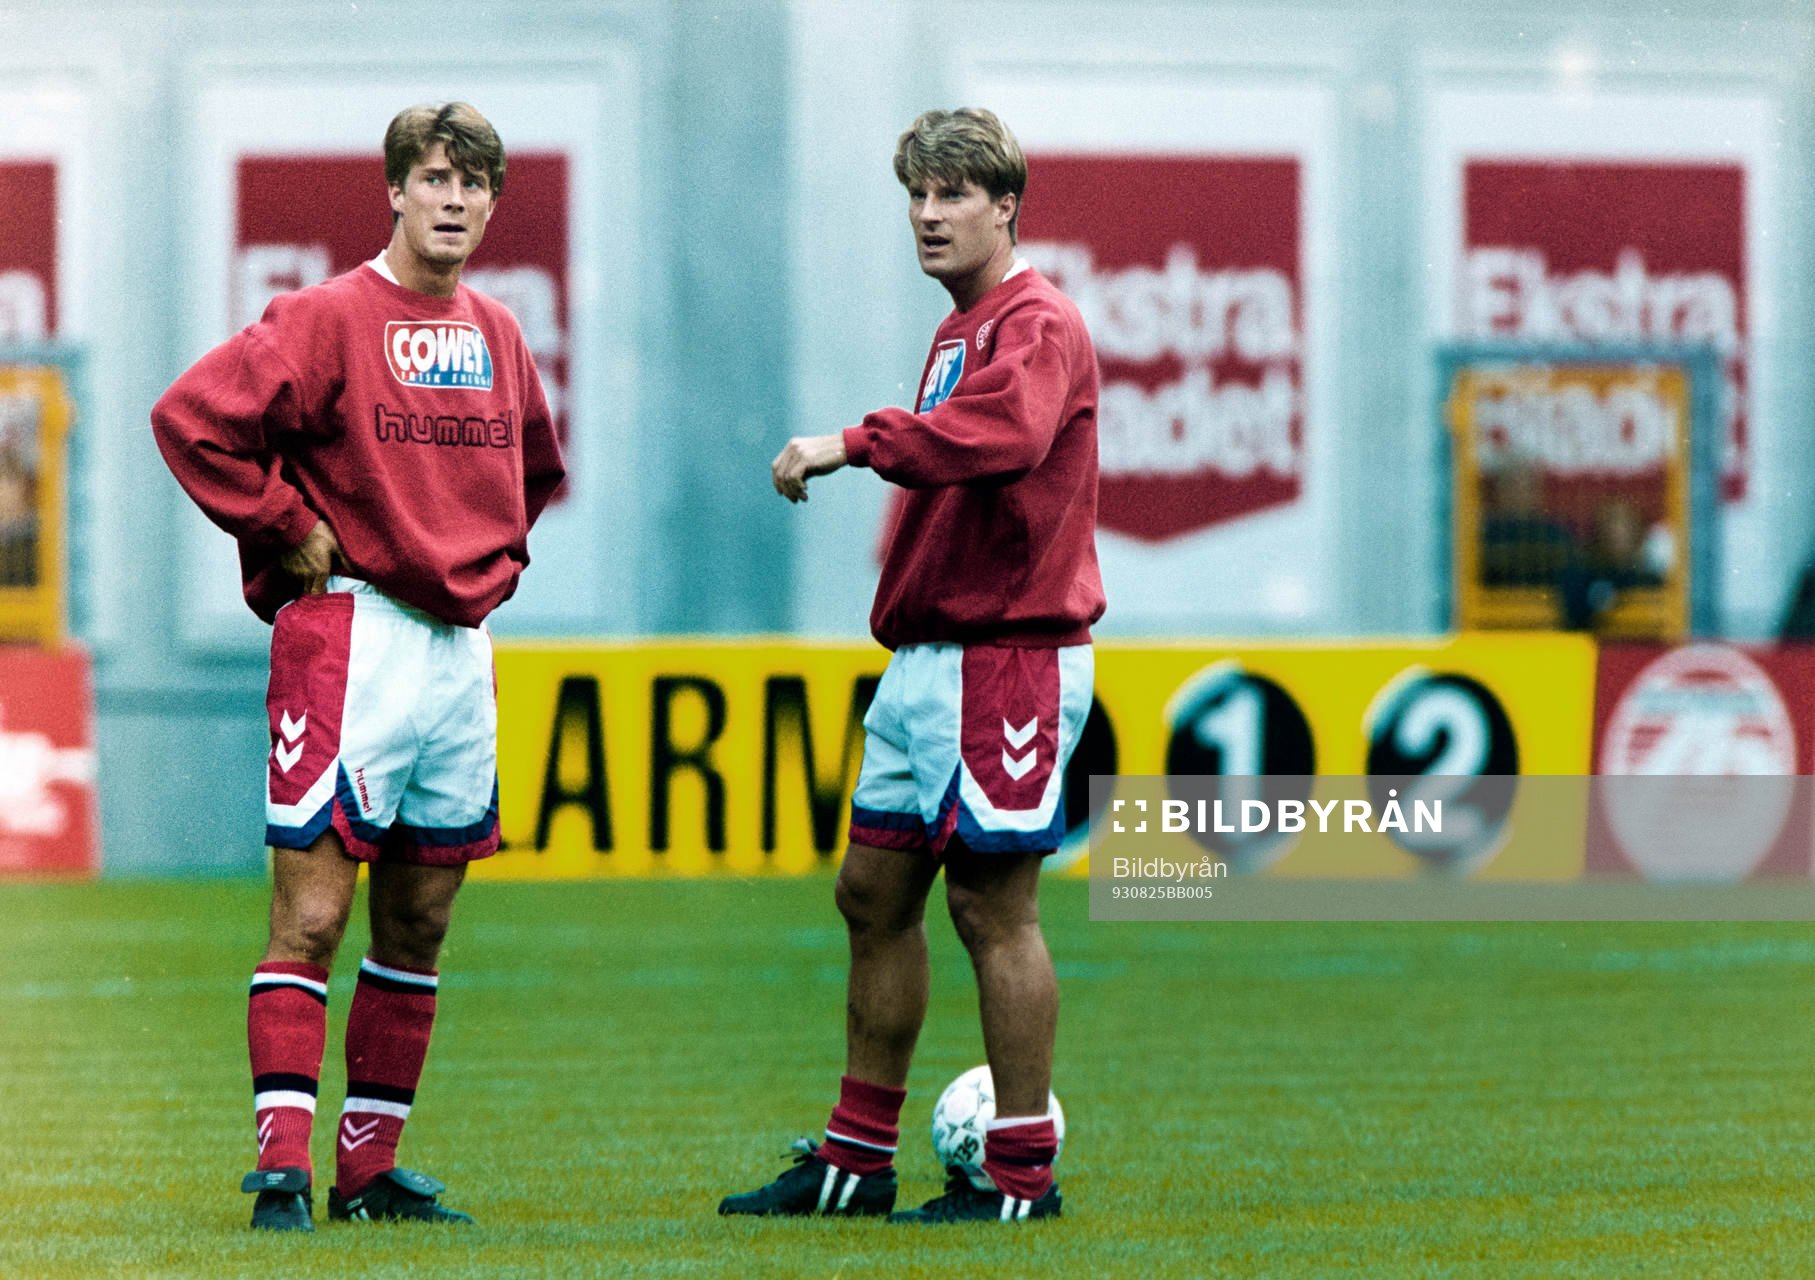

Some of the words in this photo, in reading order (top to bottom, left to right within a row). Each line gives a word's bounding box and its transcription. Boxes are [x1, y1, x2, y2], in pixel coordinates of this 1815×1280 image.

[1016, 243, 1299, 360] kstra
[392, 327, 484, 375] COWEY
[375, 403, 516, 449] hummel
[1096, 368, 1298, 478] adet
[354, 767, 373, 814] hummel
[500, 674, 886, 853] ARM
